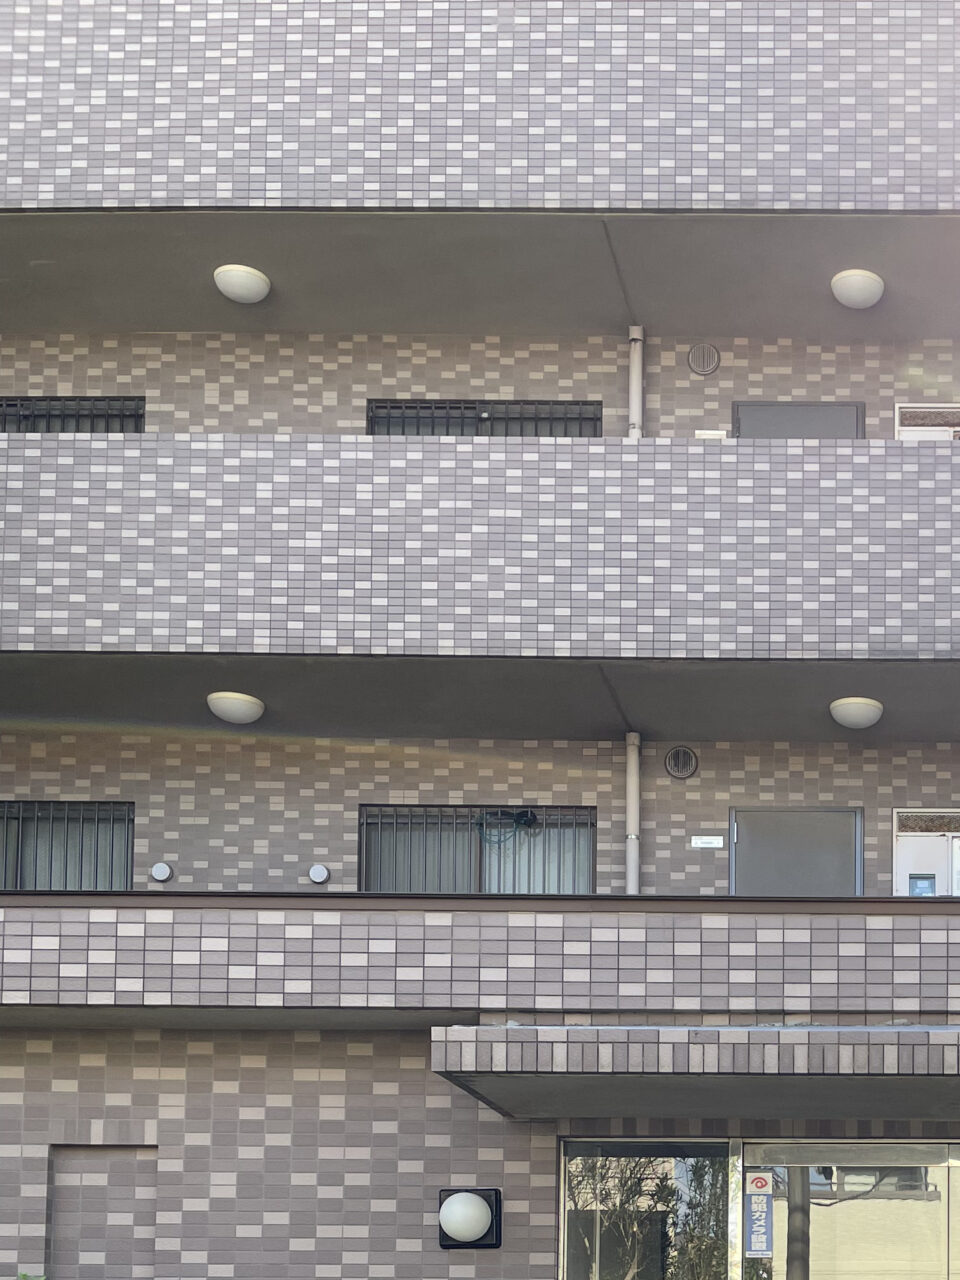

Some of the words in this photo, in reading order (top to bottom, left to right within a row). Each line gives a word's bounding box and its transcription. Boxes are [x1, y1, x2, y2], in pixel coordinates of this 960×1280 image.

[751, 1195, 767, 1251] 防犯カメラ設置
